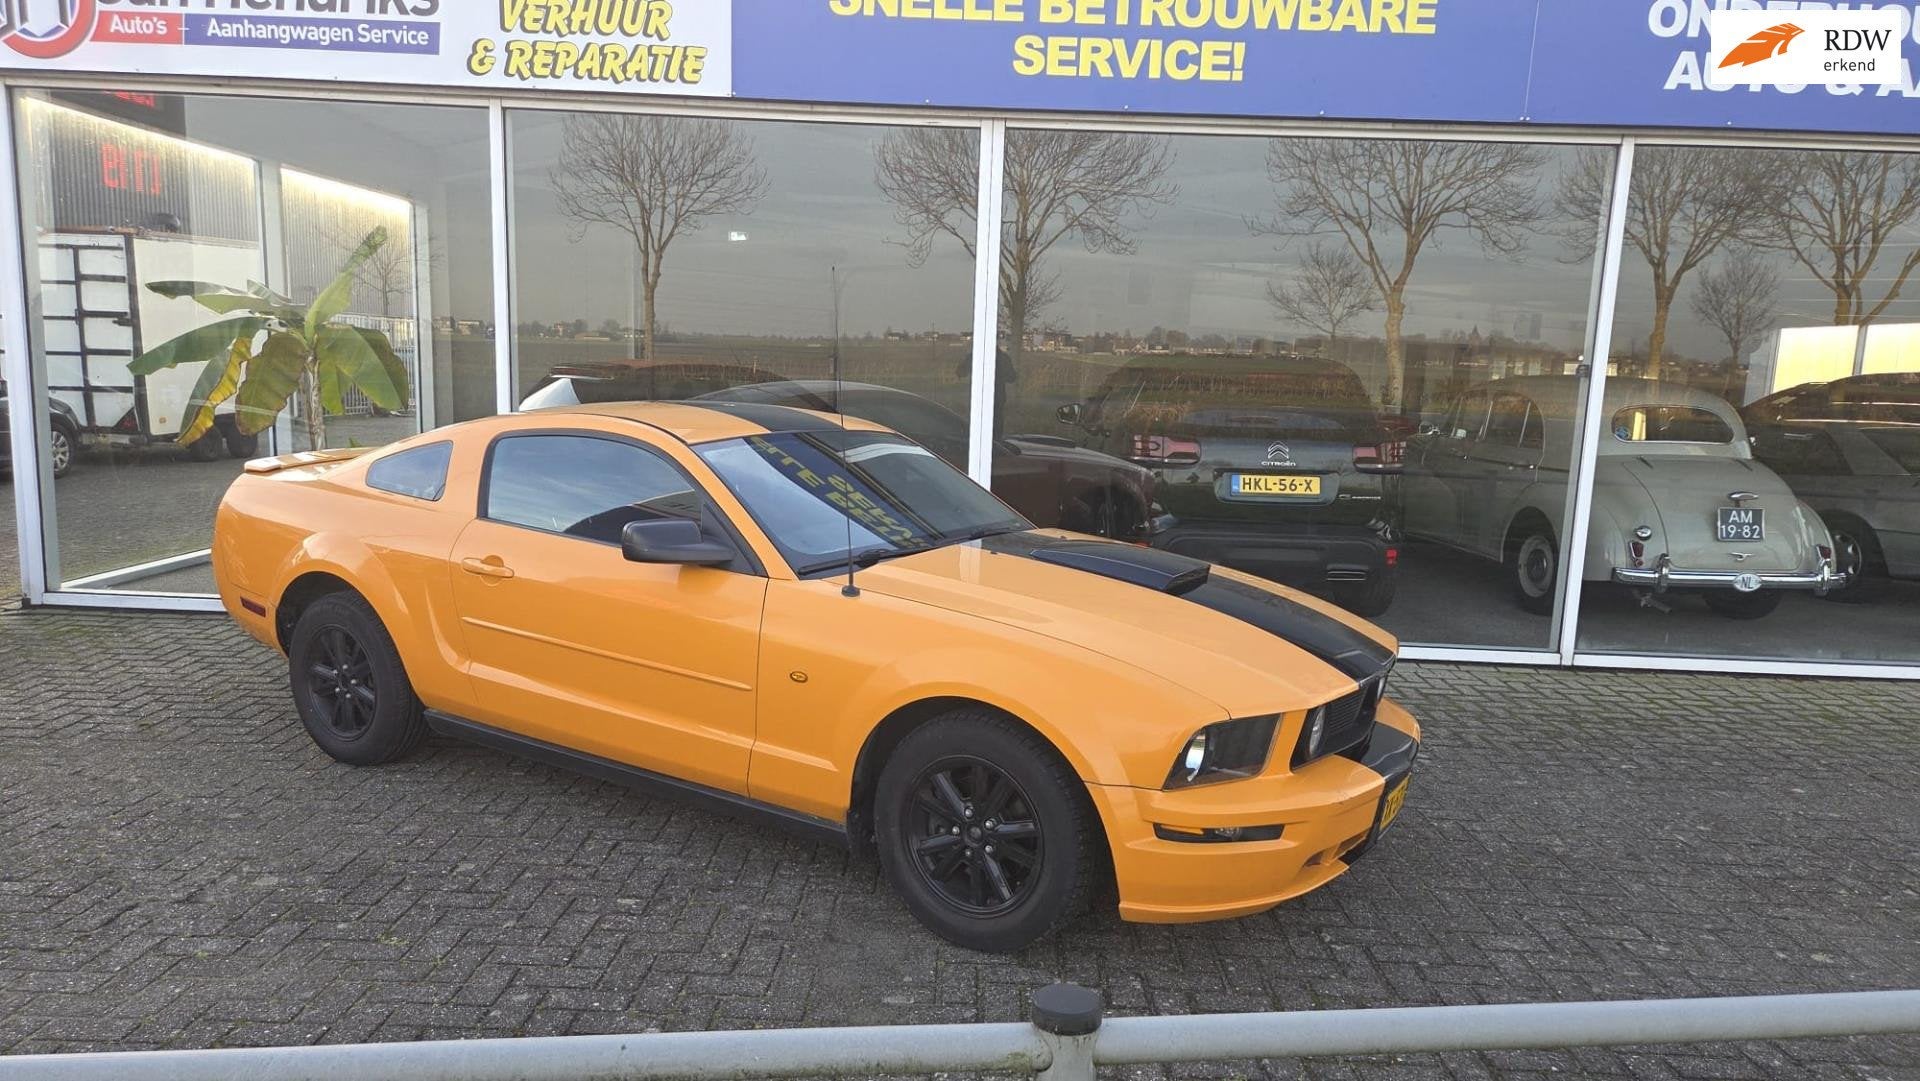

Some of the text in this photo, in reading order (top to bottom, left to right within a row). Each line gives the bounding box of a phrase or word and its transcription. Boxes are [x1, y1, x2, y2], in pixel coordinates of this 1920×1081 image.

[110, 14, 168, 35] Auto's
[206, 17, 354, 46] Aanhangwagen
[357, 23, 430, 46] Service
[498, 0, 672, 41] VERHUUR
[1038, 0, 1437, 35] BETROUWBARE
[466, 38, 708, 85] & REPARATIE
[1012, 34, 1245, 82] SERVICE!
[1242, 476, 1313, 493] HKL-56-X
[1720, 524, 1761, 539] 19-82
[1728, 509, 1754, 524] AM
[1740, 575, 1755, 590] NL
